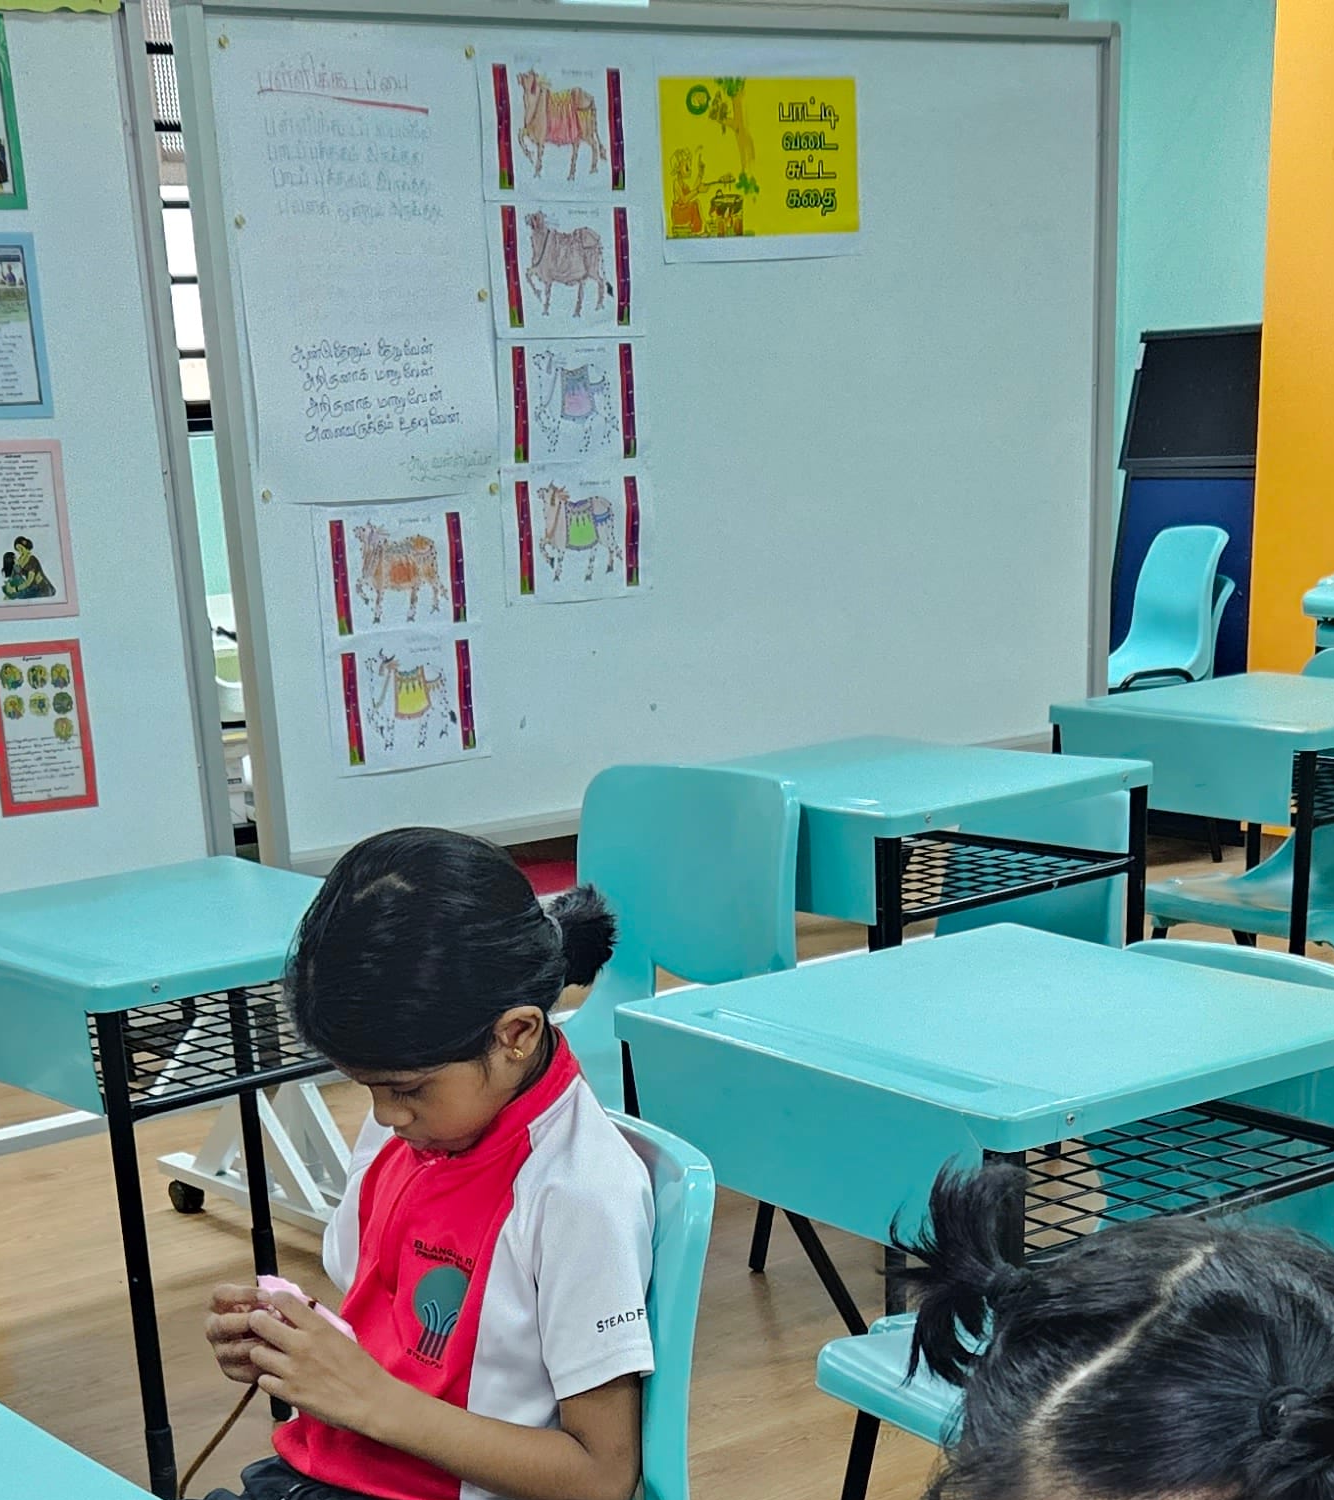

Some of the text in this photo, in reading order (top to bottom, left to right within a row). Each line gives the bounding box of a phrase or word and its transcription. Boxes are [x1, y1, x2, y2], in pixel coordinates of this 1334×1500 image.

[778, 96, 839, 130] பாட்டி
[782, 131, 839, 151] வடை
[785, 154, 837, 180] சுட்ட
[786, 188, 837, 216] கதை
[596, 1308, 646, 1333] STEADF
